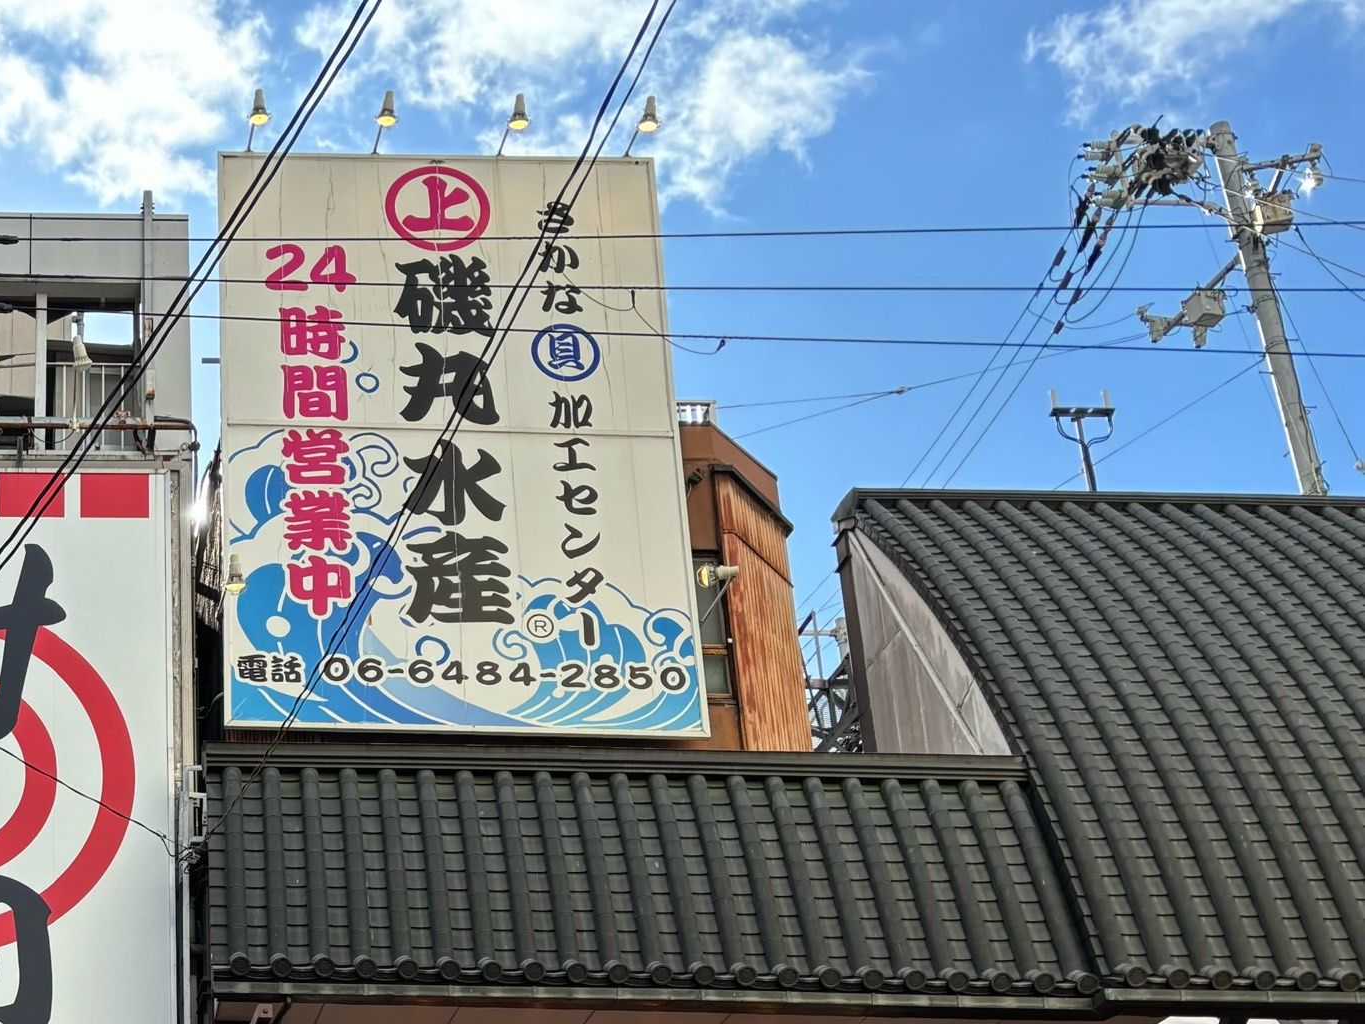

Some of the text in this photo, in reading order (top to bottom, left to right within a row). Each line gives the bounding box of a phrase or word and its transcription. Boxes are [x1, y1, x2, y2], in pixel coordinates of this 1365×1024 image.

[265, 243, 357, 617] 24時間営業中
[393, 253, 515, 626] 磯丸水産
[237, 654, 688, 692] 電話 06-6484-2850
